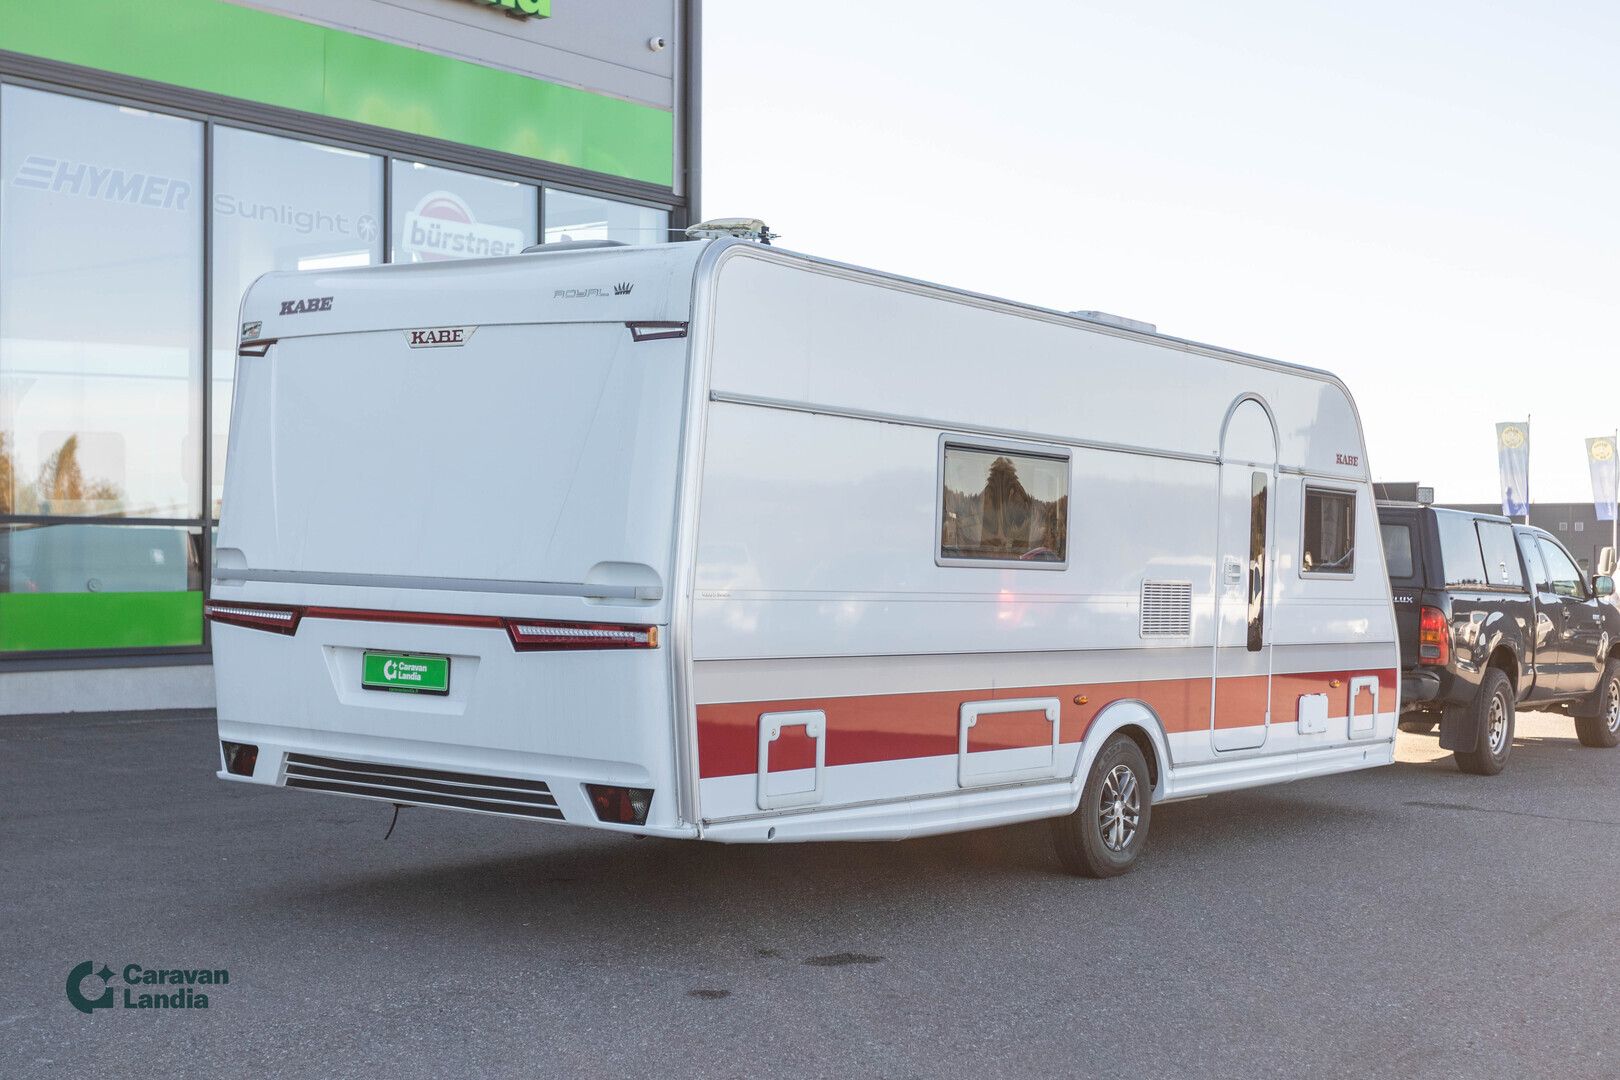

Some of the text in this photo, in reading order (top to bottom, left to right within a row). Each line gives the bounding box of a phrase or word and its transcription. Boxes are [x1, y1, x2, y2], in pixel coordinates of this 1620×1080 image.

[51, 159, 192, 211] HYMER
[214, 193, 350, 235] Sunlight
[410, 219, 516, 256] bürstner
[279, 296, 334, 316] KABE
[410, 329, 464, 344] KABE
[1335, 453, 1359, 467] KABE
[1392, 596, 1414, 604] LUX
[398, 662, 427, 672] Caravan
[398, 671, 421, 680] Landia
